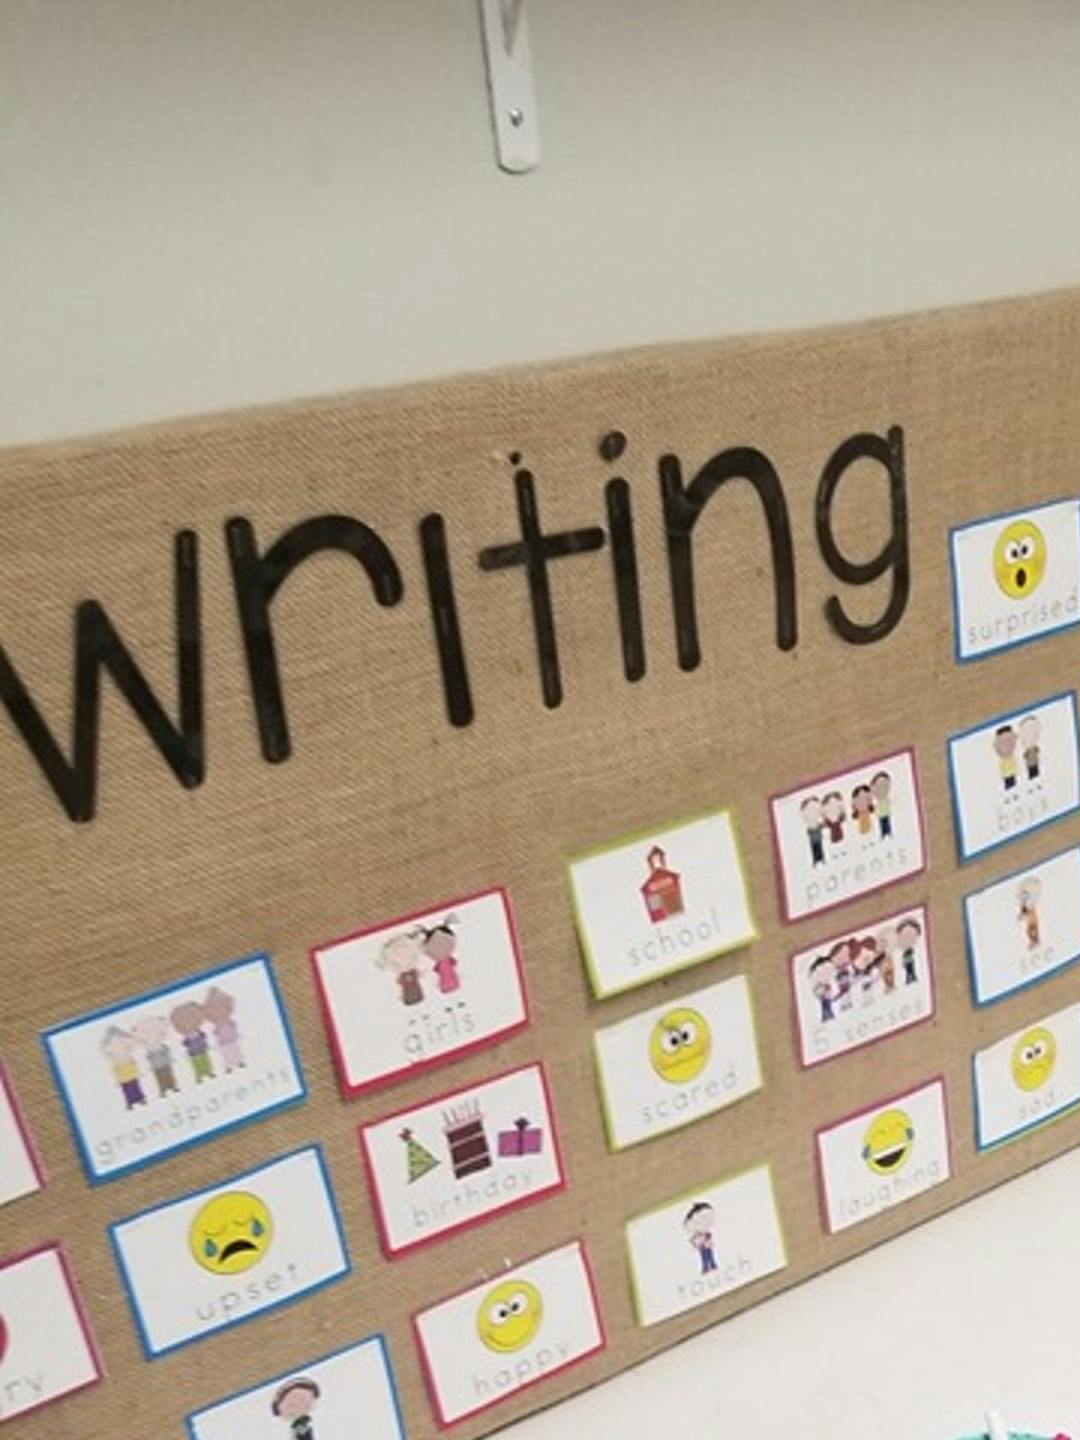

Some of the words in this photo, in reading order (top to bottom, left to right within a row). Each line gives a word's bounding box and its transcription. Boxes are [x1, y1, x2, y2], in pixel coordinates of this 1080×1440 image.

[0, 425, 911, 823] writing
[967, 584, 1079, 645] surprised
[805, 846, 909, 902] parents
[628, 910, 720, 968] school
[404, 1012, 476, 1057] girls
[814, 1028, 827, 1056] 5
[843, 998, 924, 1043] senses
[98, 1067, 290, 1166] grandparents
[642, 1063, 738, 1125] scared
[412, 1167, 534, 1228] birthday
[839, 1157, 939, 1219] laughing
[195, 1263, 301, 1322] upset
[676, 1256, 754, 1299] touch
[472, 1340, 570, 1394] happy
